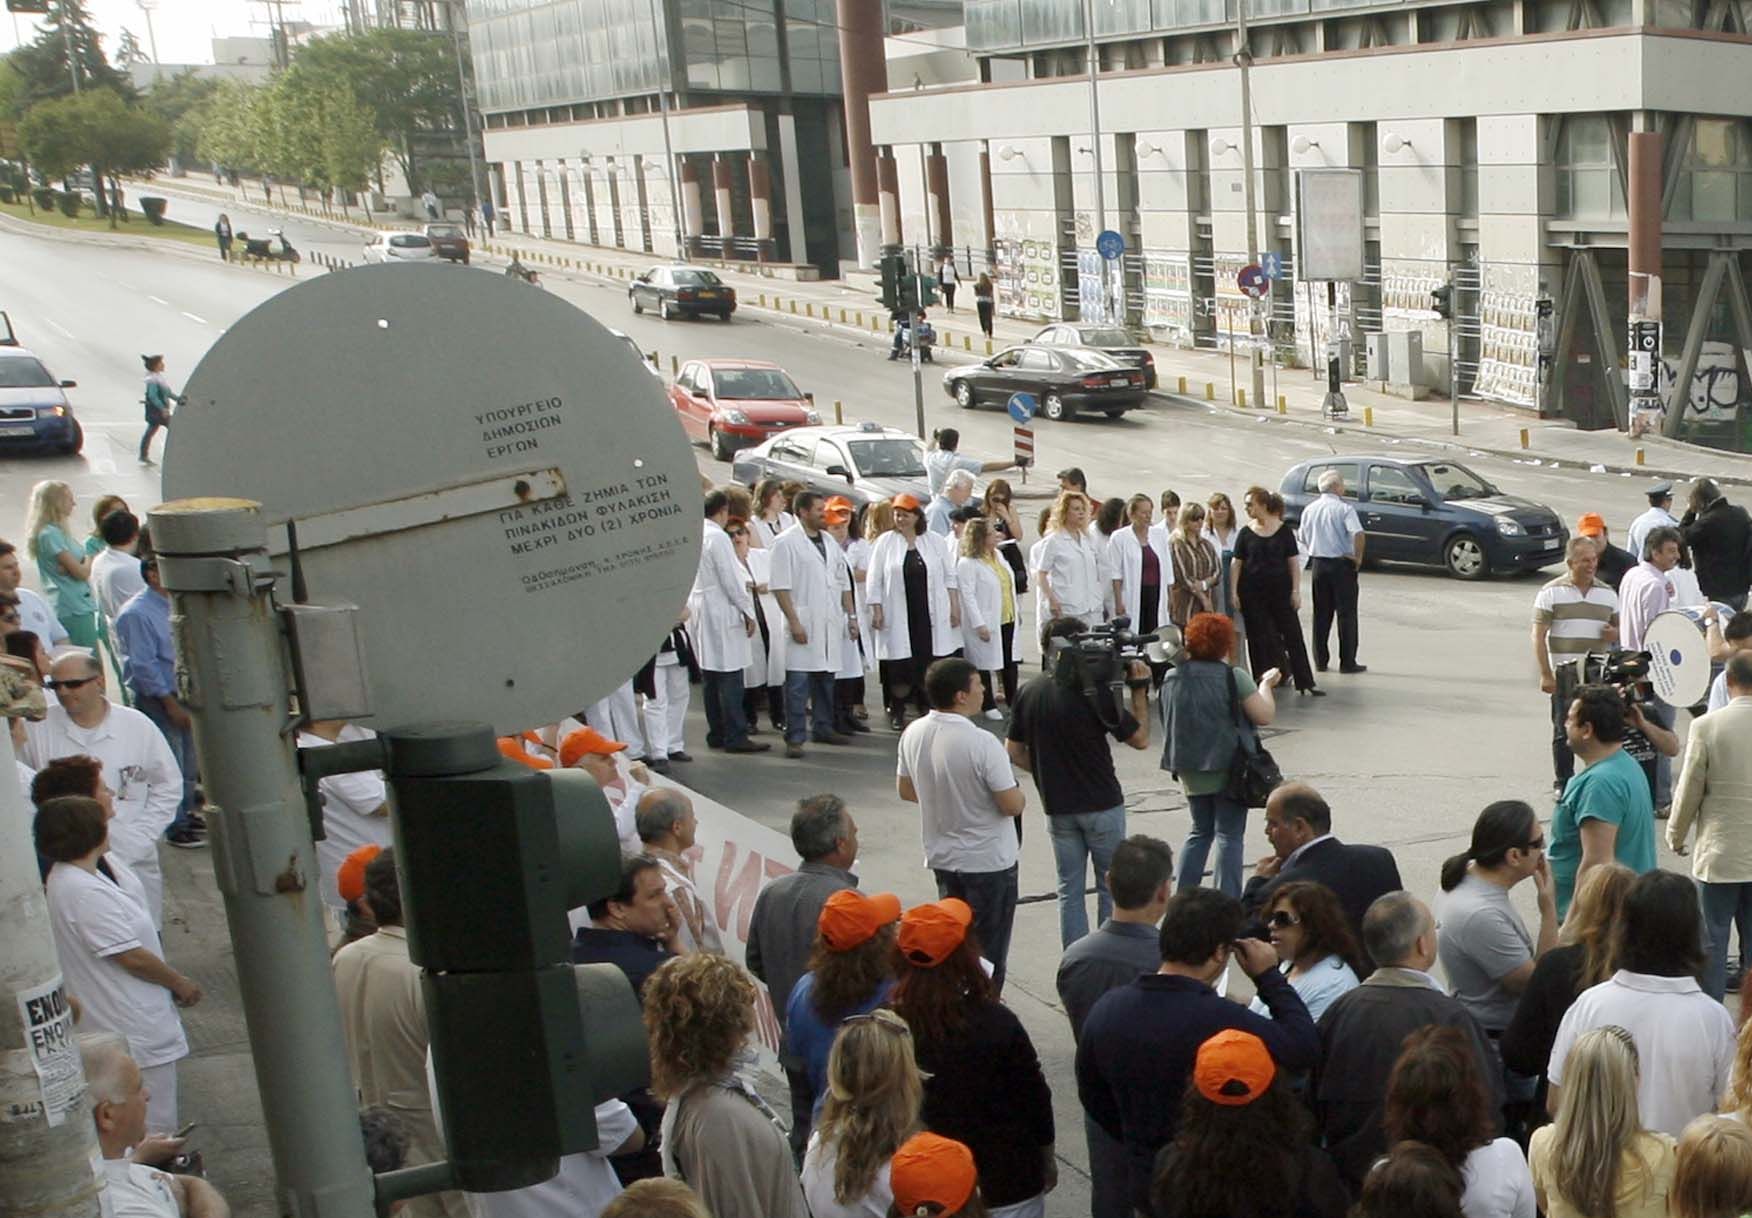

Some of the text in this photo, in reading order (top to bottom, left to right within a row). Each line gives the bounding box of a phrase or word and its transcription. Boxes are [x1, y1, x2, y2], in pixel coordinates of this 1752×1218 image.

[475, 396, 562, 424] ΥΠΟΥΡΓΕΙΟ
[482, 414, 561, 442] ΔΗΜΟΣΙΩΝ
[487, 438, 538, 458] ΕΡΓΩΝ
[500, 473, 668, 524] ΓΙΑ ΚΑΘΕ ΖΗΜΙΑ ΤΩΝ
[505, 489, 671, 539] ΠΙΝΑΚΙΔΩΝ ΦΥΛΑΚΙΣΗ
[511, 504, 682, 554] ΜΕΧΡΙ ΔΥΟ (2) ΧΡΟΝΙΑ
